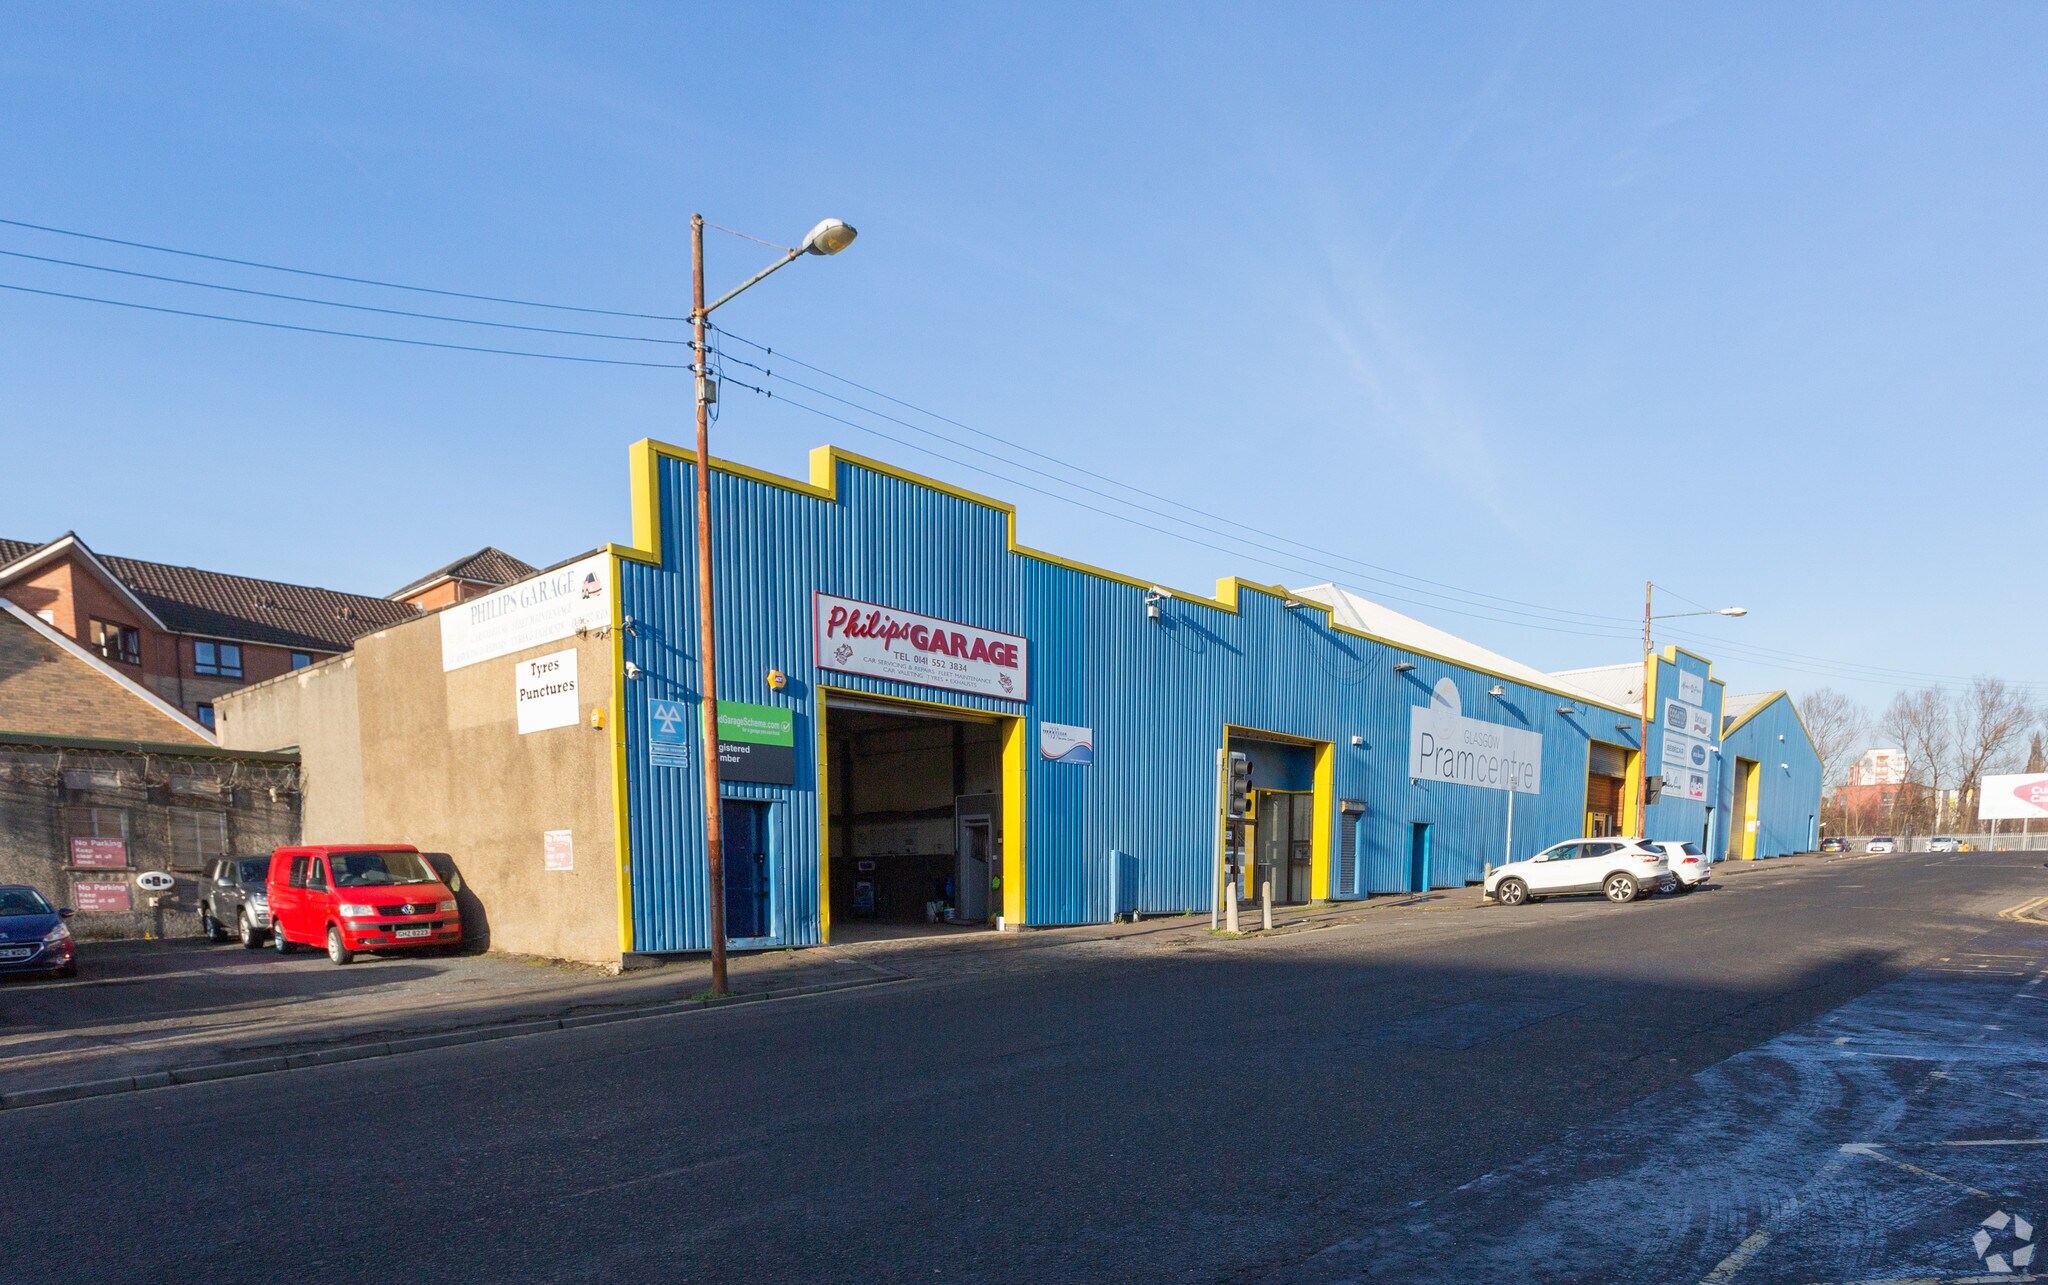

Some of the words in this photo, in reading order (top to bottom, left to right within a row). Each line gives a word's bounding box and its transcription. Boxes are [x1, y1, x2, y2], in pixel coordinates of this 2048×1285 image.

[471, 591, 517, 625] PHILIPS
[520, 570, 575, 609] GARAGE
[827, 605, 910, 651] Philips
[910, 625, 1018, 668] GARAGE
[531, 660, 559, 678] Tyres
[863, 656, 876, 664] CAR
[877, 658, 907, 669] SERVICING
[914, 666, 935, 674] REPAIRS
[938, 670, 953, 678] FLEET
[954, 673, 992, 684] MAINTENANCE
[893, 651, 910, 662] TEL
[913, 655, 928, 665] 0141
[931, 658, 946, 669] 552
[949, 662, 967, 672] 3834
[897, 670, 924, 679] VALETING
[927, 674, 944, 682] TYRES
[949, 678, 977, 688] EXHAUSTS
[520, 681, 575, 701] Punctures
[717, 714, 780, 730] dGarageScheme.com
[718, 743, 751, 754] gistered
[1464, 730, 1500, 750] GLASGOW
[719, 754, 741, 763] mber
[1420, 732, 1533, 789] Pramcentre
[94, 884, 126, 892] Parking
